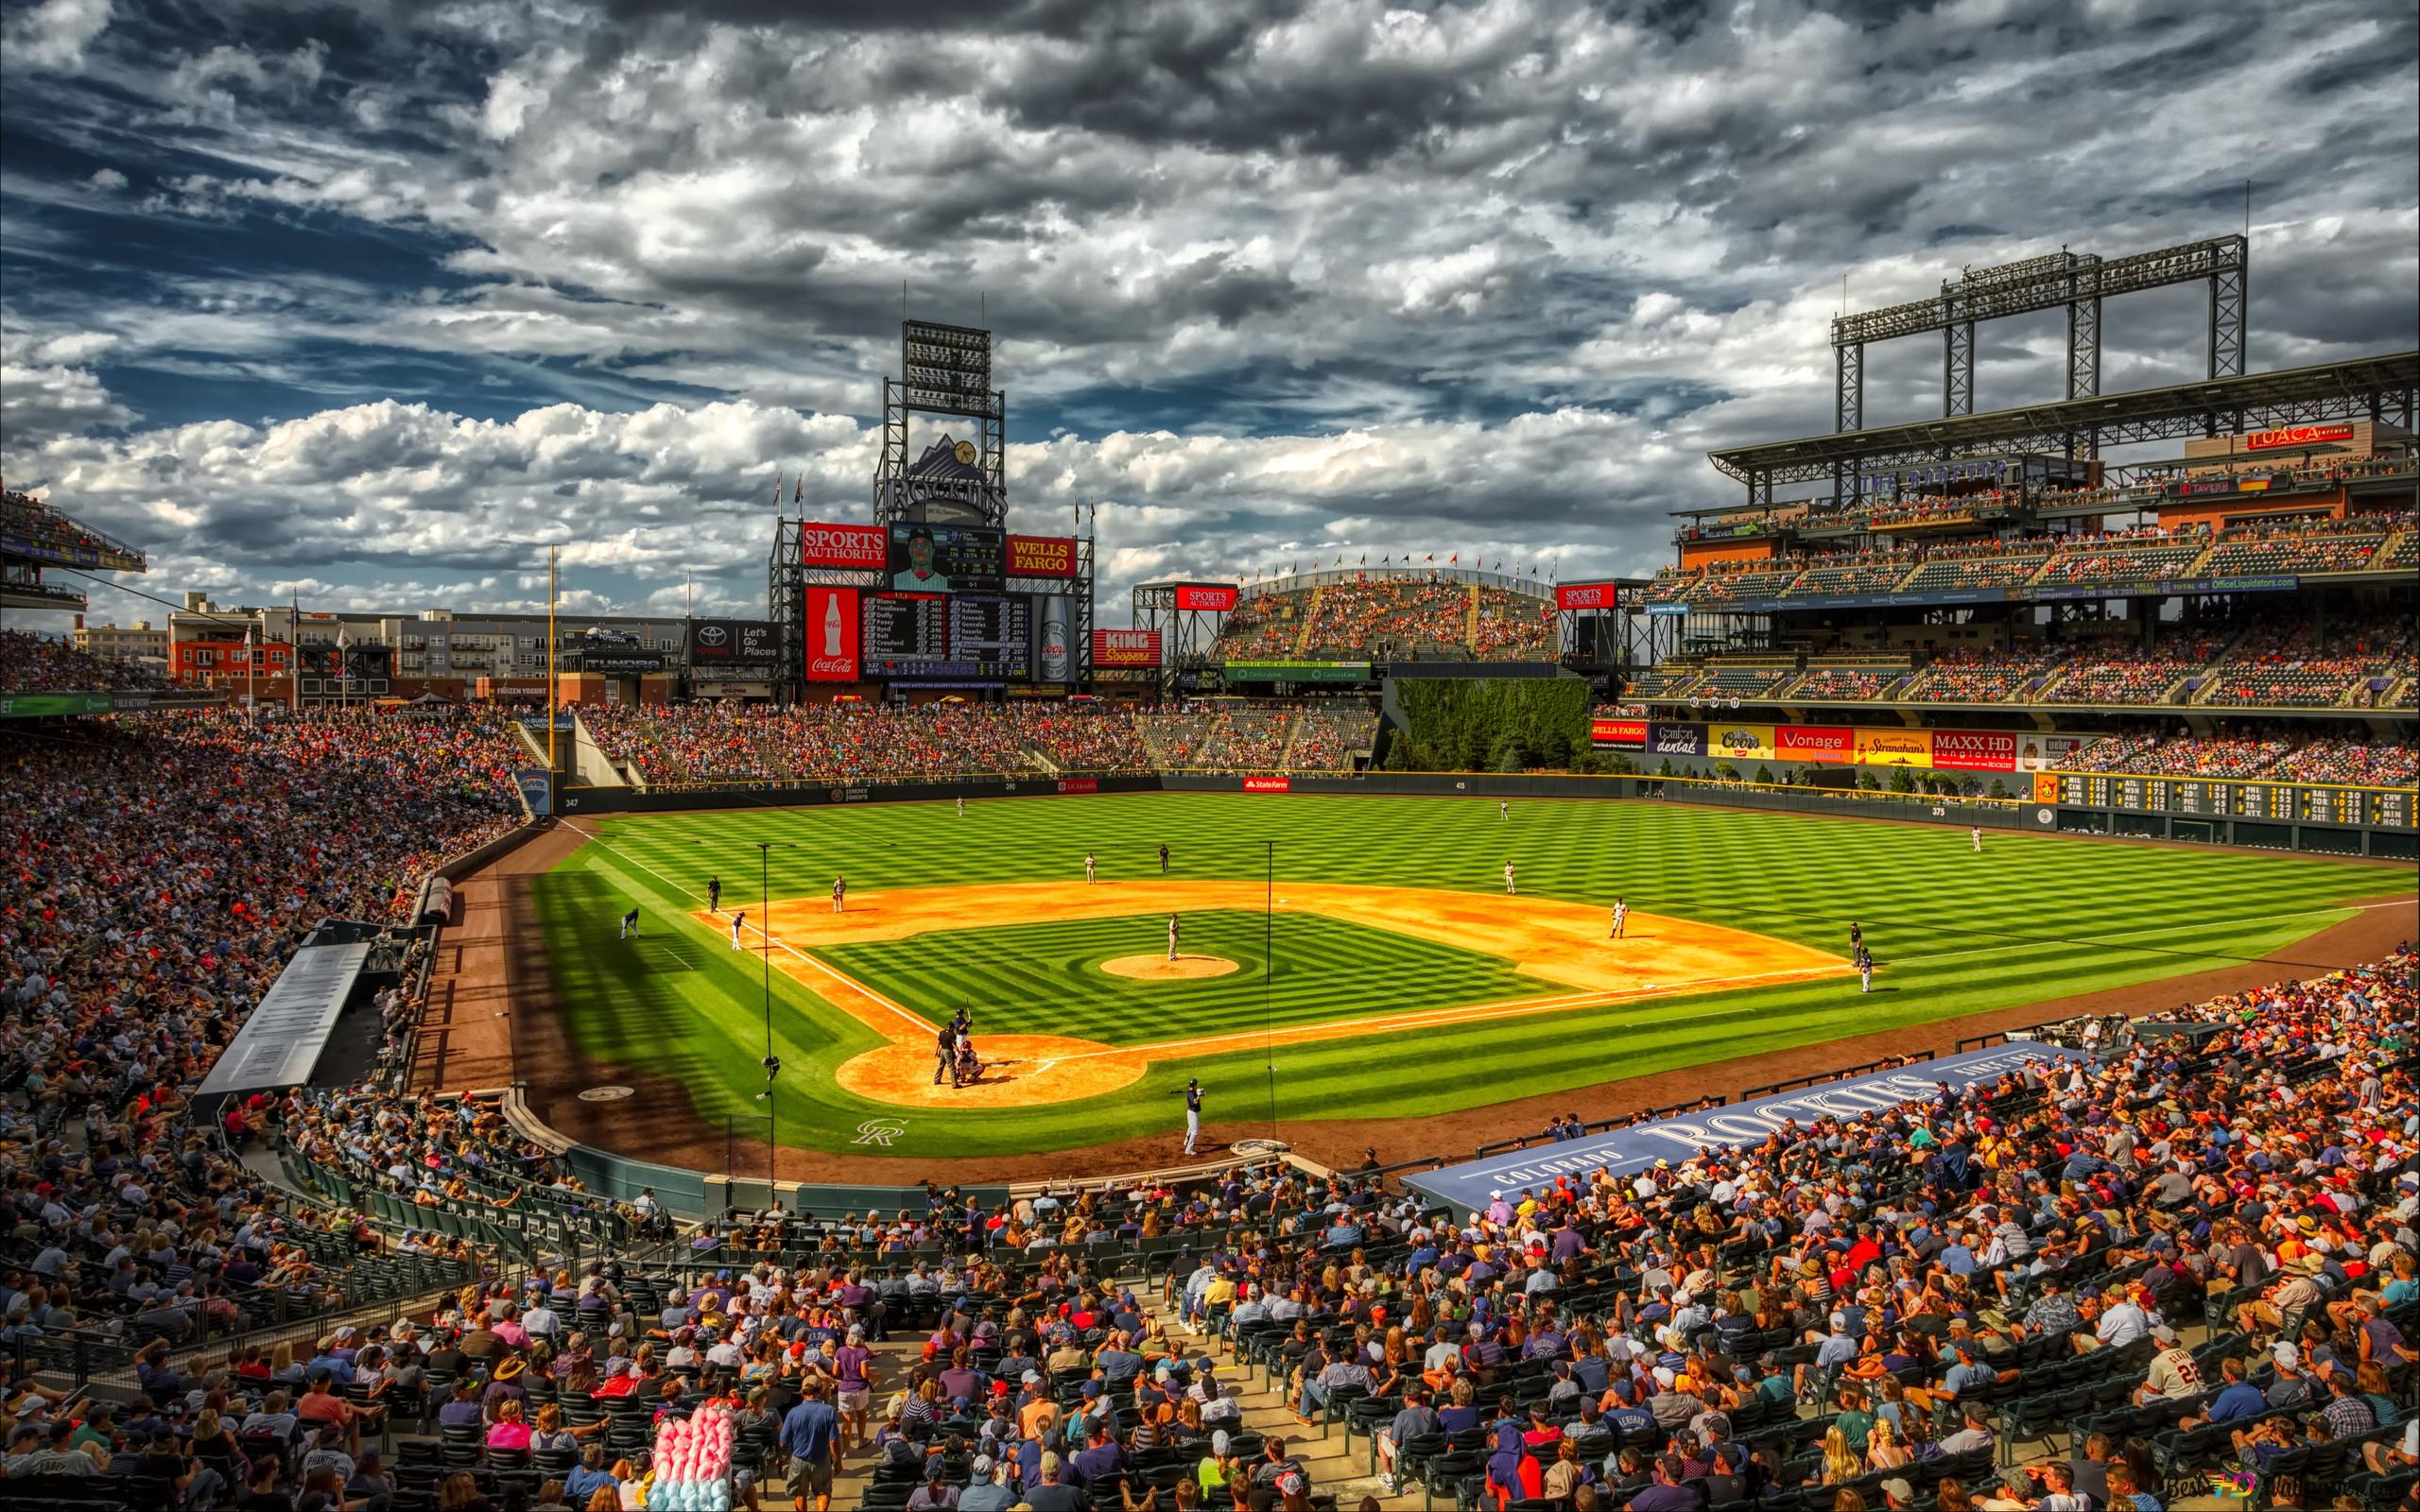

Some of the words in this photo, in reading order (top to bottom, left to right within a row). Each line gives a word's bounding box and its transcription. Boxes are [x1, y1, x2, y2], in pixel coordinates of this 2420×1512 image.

[2250, 427, 2319, 445] TUACA
[1910, 460, 2007, 489] ROOFTOP
[883, 477, 1009, 516] ROCKIES
[805, 530, 884, 550] SPORTS
[1013, 542, 1067, 557] WELLS
[1015, 556, 1067, 571] FARGO
[2213, 578, 2294, 590] OfficeLiquidators.com
[1190, 591, 1227, 602] SPORTS
[1566, 589, 1601, 600] SPORTS
[599, 634, 625, 643] TOYOTA
[744, 627, 767, 636] Let's
[744, 637, 758, 646] Go
[1106, 633, 1149, 648] KING
[744, 647, 777, 656] Places
[1105, 648, 1150, 665] Soopers
[586, 660, 659, 669] TUNDRA
[812, 658, 853, 673] Coca-Cola
[1592, 726, 1617, 734] WELLS
[1618, 727, 1645, 735] FARGO
[1722, 731, 1760, 749] Coors
[1784, 733, 1843, 749] Vonage
[1869, 739, 1925, 755] Stranahan's
[1936, 735, 1985, 750] MAXX
[1989, 738, 2013, 751] HD
[2048, 740, 2072, 750] weber
[1935, 750, 2012, 760] sunglasses
[1067, 782, 1097, 790] UCHealth
[566, 799, 579, 808] 347
[1932, 807, 1945, 816] 375
[1954, 1061, 2003, 1076] SINCE
[1635, 1074, 1961, 1152] ROCKIES
[1494, 1150, 1624, 1185] COLORADO
[1935, 1163, 1944, 1174] 28
[2177, 1361, 2204, 1384] 22
